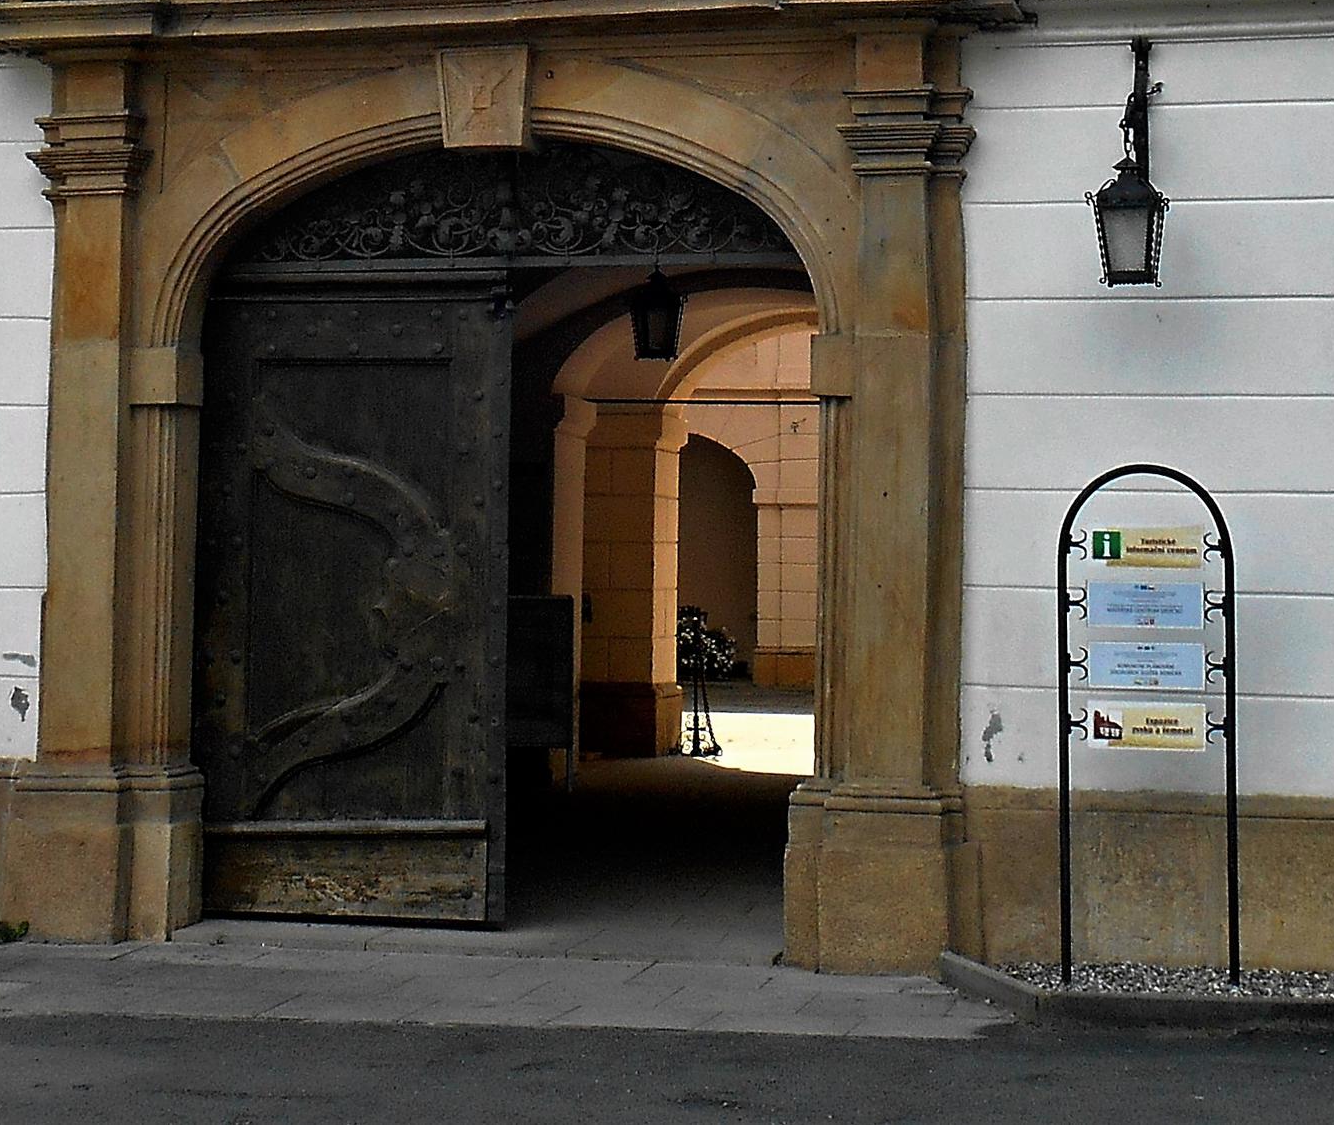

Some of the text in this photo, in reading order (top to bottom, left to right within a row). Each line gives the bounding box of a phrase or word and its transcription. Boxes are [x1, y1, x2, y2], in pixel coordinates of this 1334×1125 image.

[1141, 537, 1177, 546] Turistické
[1167, 547, 1198, 555] centrum
[1145, 717, 1180, 725] Expozice
